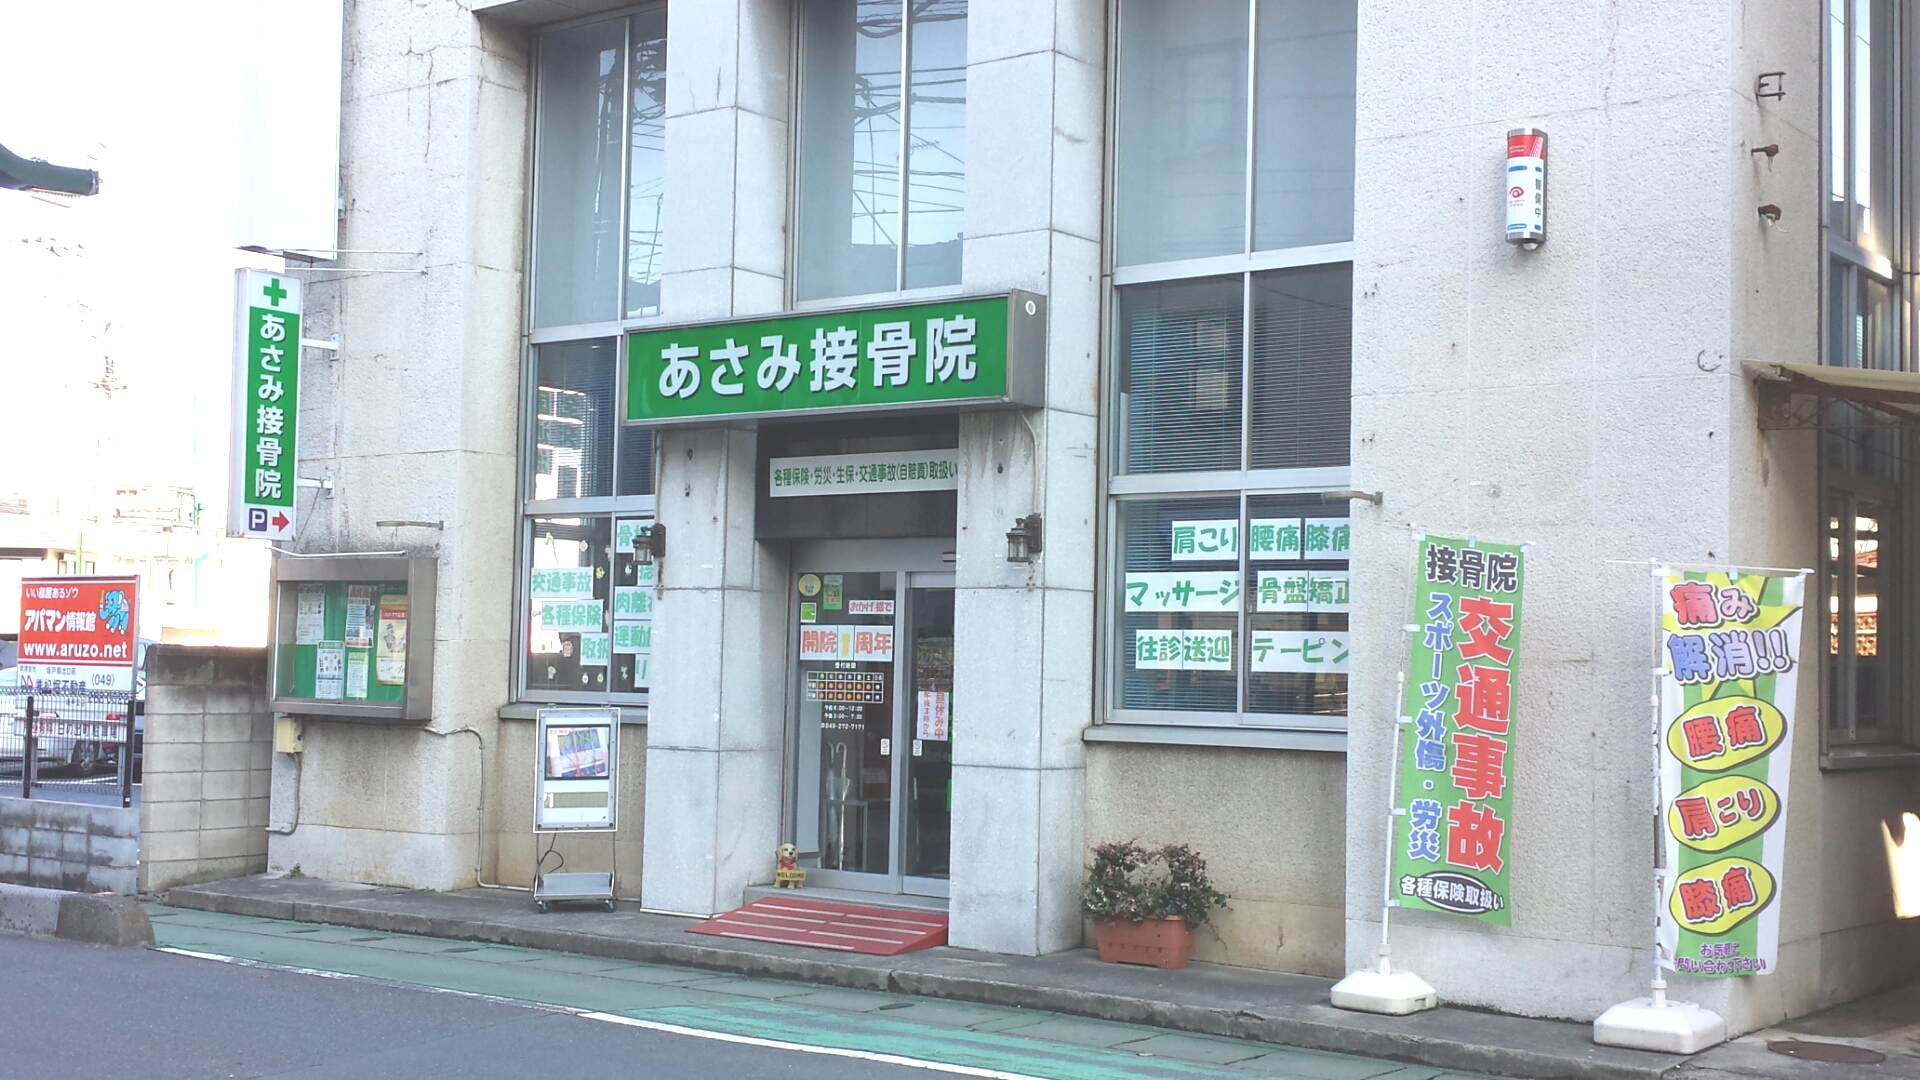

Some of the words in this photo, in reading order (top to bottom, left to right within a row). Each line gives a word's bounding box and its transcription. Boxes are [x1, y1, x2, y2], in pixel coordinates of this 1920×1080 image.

[659, 314, 977, 399] あさみ接骨院
[255, 313, 286, 499] あさみ接骨院
[1173, 526, 1237, 554] 肩こり
[1250, 525, 1299, 552] 腰痛
[531, 572, 592, 592] 交通事故
[1425, 545, 1518, 592] 接骨院
[850, 602, 893, 614] おかげ様で
[1126, 580, 1239, 606] マッサージ
[1669, 582, 1758, 628] 痛み
[24, 608, 97, 632] アパマン情報館
[541, 604, 601, 627] 各種保険
[23, 642, 127, 658] www.aruzo.net
[801, 631, 891, 657] 開院1周年
[1136, 635, 1229, 662] 往診送迎
[91, 674, 115, 686] (049)
[934, 691, 946, 739] 昼休み中
[1446, 597, 1515, 875] 交通事故
[1683, 705, 1765, 760] 腰痛
[1675, 788, 1764, 839] 肩こり
[1401, 875, 1504, 911] 各種保険取扱い
[1679, 866, 1757, 923] 膝痛
